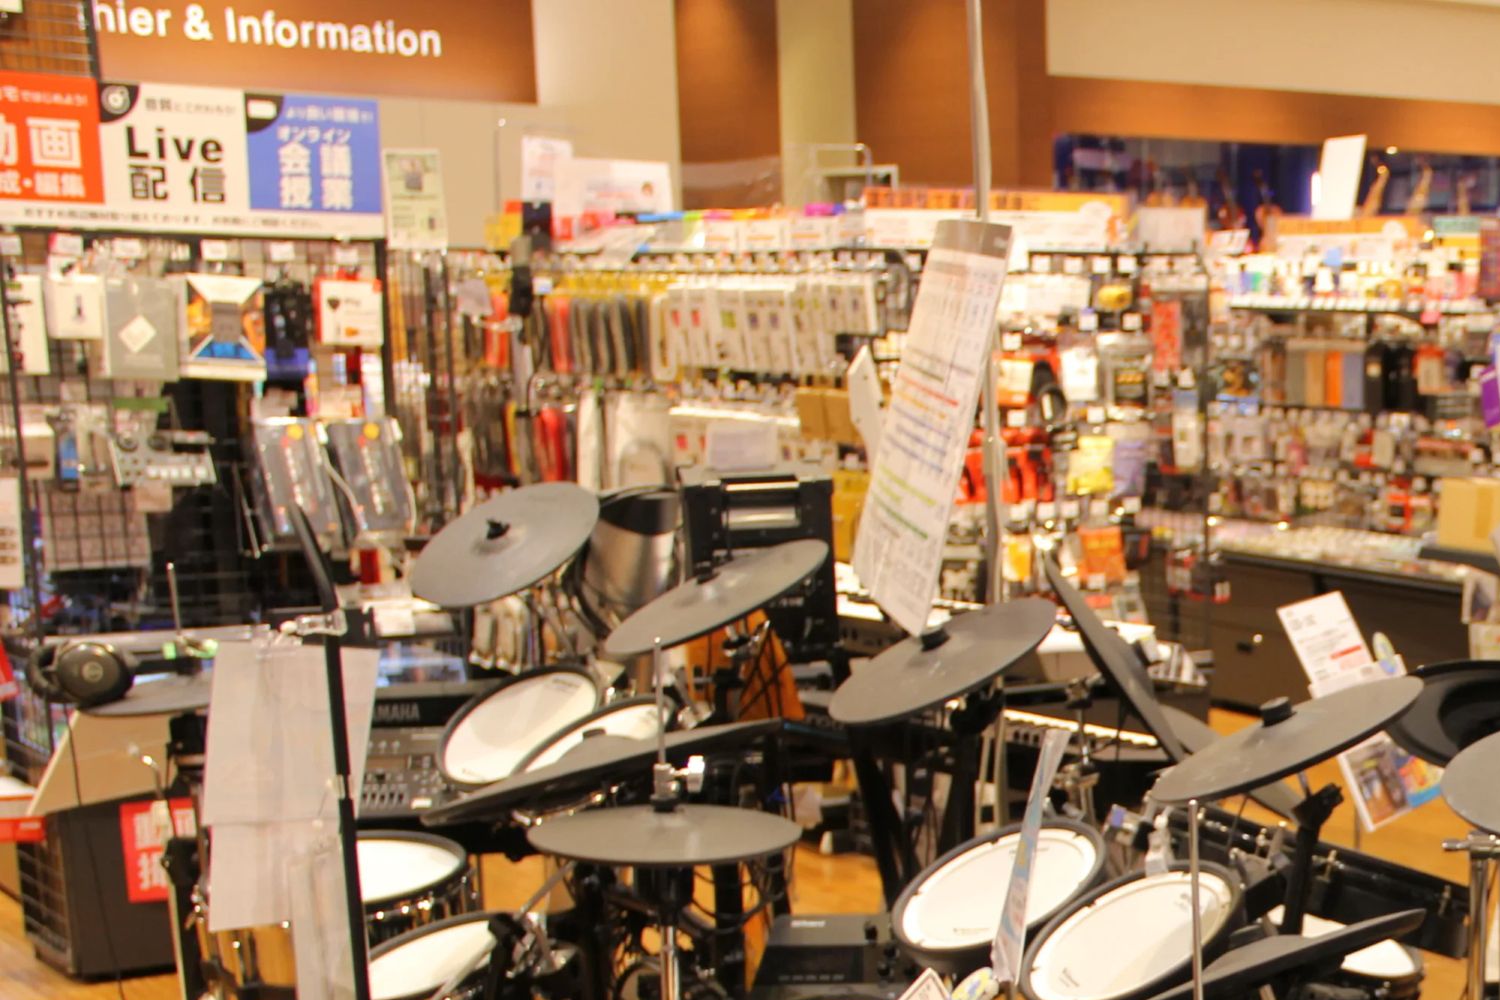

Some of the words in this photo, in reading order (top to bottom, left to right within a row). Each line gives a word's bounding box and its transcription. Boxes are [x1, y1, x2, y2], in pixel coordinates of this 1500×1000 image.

[184, 4, 213, 41] &
[225, 7, 443, 57] Information
[126, 126, 223, 163] Live
[277, 125, 351, 143] オンライン
[129, 164, 225, 202] 配信
[375, 702, 420, 721] MAHA
